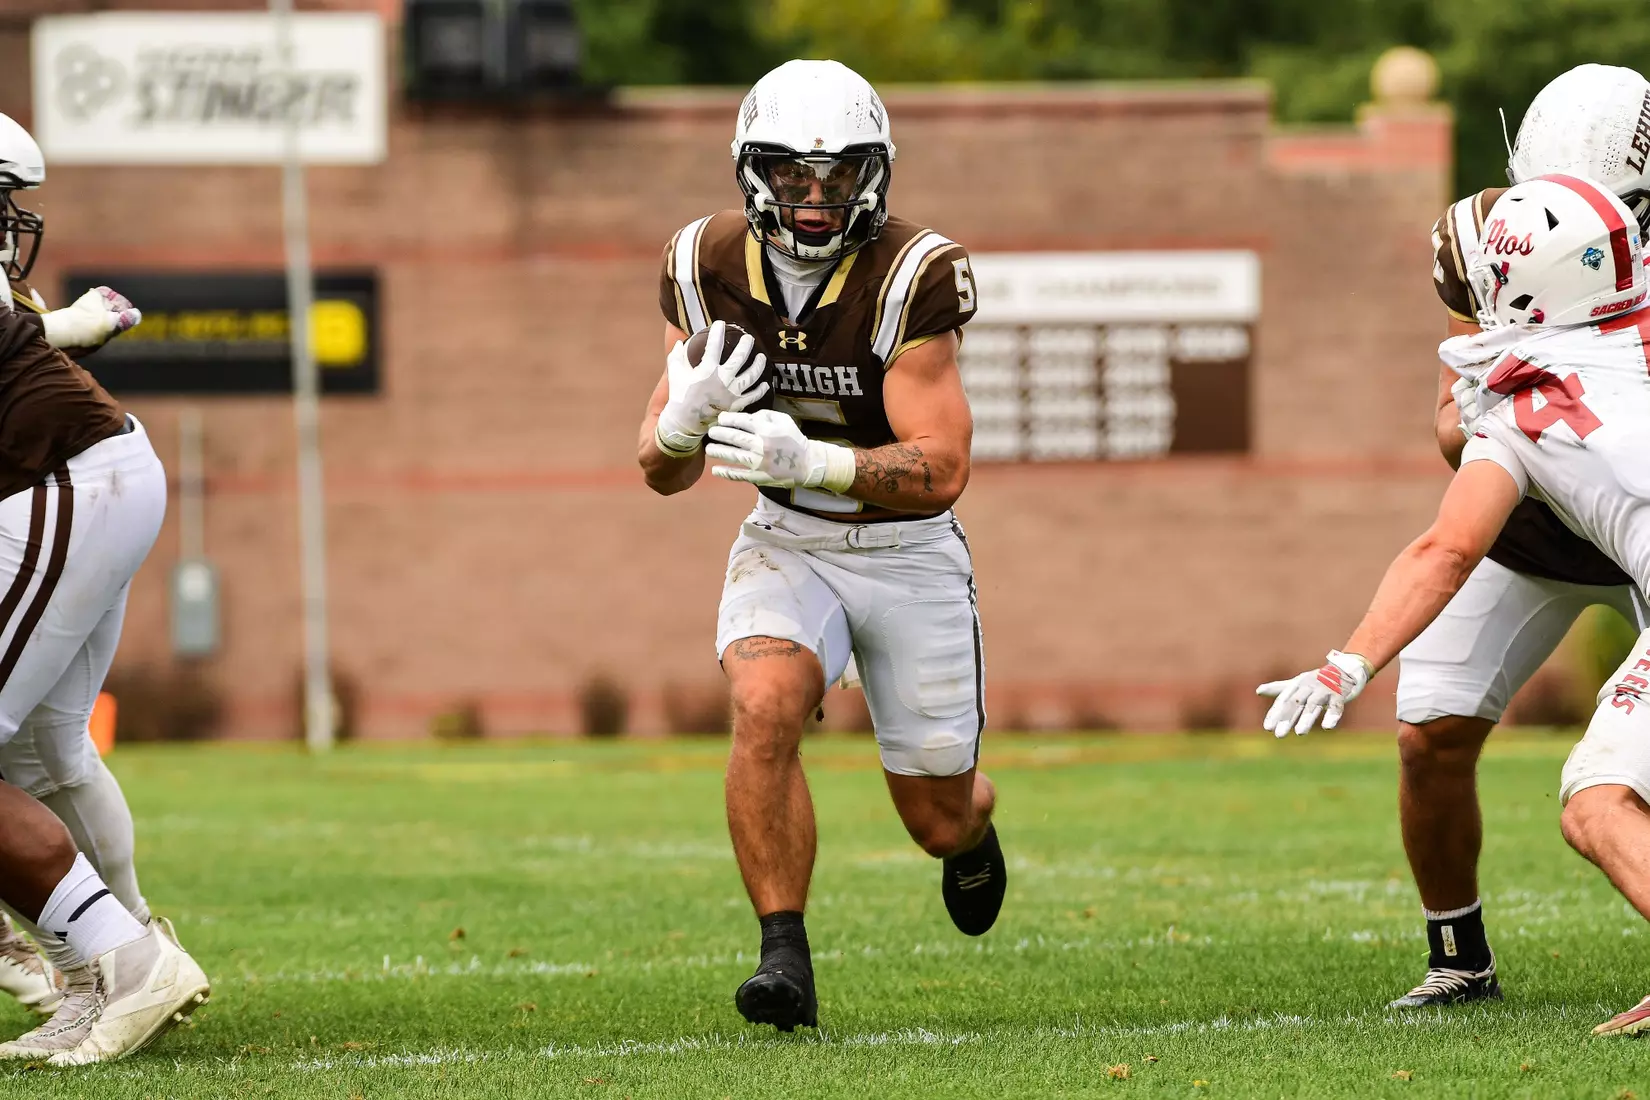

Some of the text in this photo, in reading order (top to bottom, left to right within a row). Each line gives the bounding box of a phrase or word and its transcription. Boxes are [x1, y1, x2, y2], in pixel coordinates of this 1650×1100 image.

[1484, 218, 1534, 257] Pios
[951, 257, 976, 313] 5
[1590, 298, 1633, 317] SACRED
[772, 363, 864, 396] HIGH
